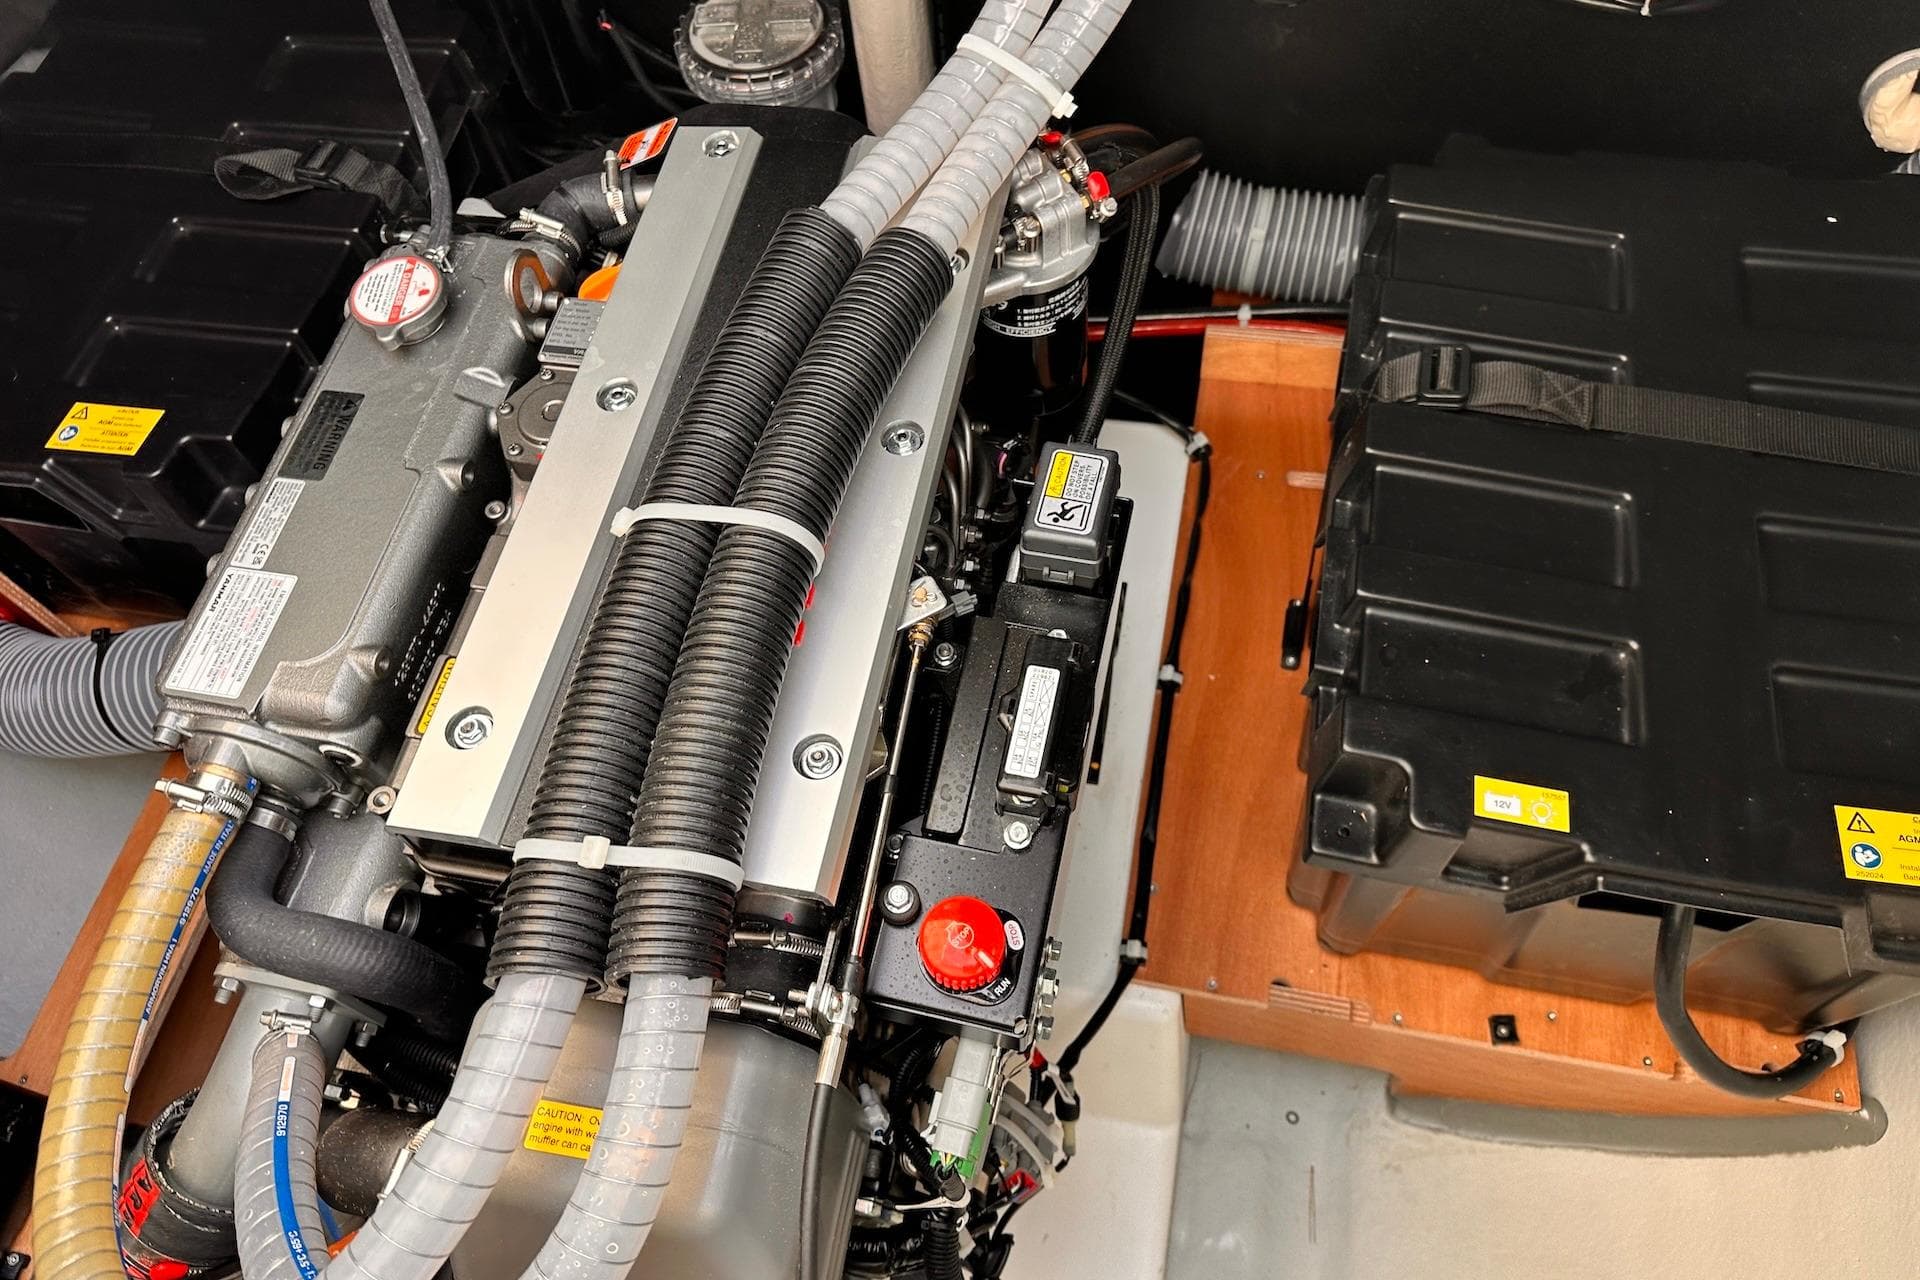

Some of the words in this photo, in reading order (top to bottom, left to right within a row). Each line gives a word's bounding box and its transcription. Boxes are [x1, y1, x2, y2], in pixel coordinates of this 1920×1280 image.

[313, 415, 352, 470] WARNING
[1055, 456, 1067, 485] CAUTION
[1066, 487, 1073, 496] DO
[208, 573, 234, 613] YANMAR
[1494, 799, 1511, 809] 12V
[1856, 870, 1884, 879] 252024
[145, 960, 168, 1016] ARMORVIN
[178, 886, 200, 927] 912970
[202, 847, 219, 875] MADE
[219, 820, 234, 838] ITAL
[952, 926, 970, 946] STOP
[1008, 923, 1021, 946] STOP
[994, 977, 1011, 997] RUN
[276, 1104, 288, 1137] 912970
[537, 1107, 584, 1123] CAUTION:
[533, 1121, 562, 1133] engine
[566, 1126, 583, 1137] with
[529, 1134, 560, 1146] muffler
[562, 1140, 578, 1150] can
